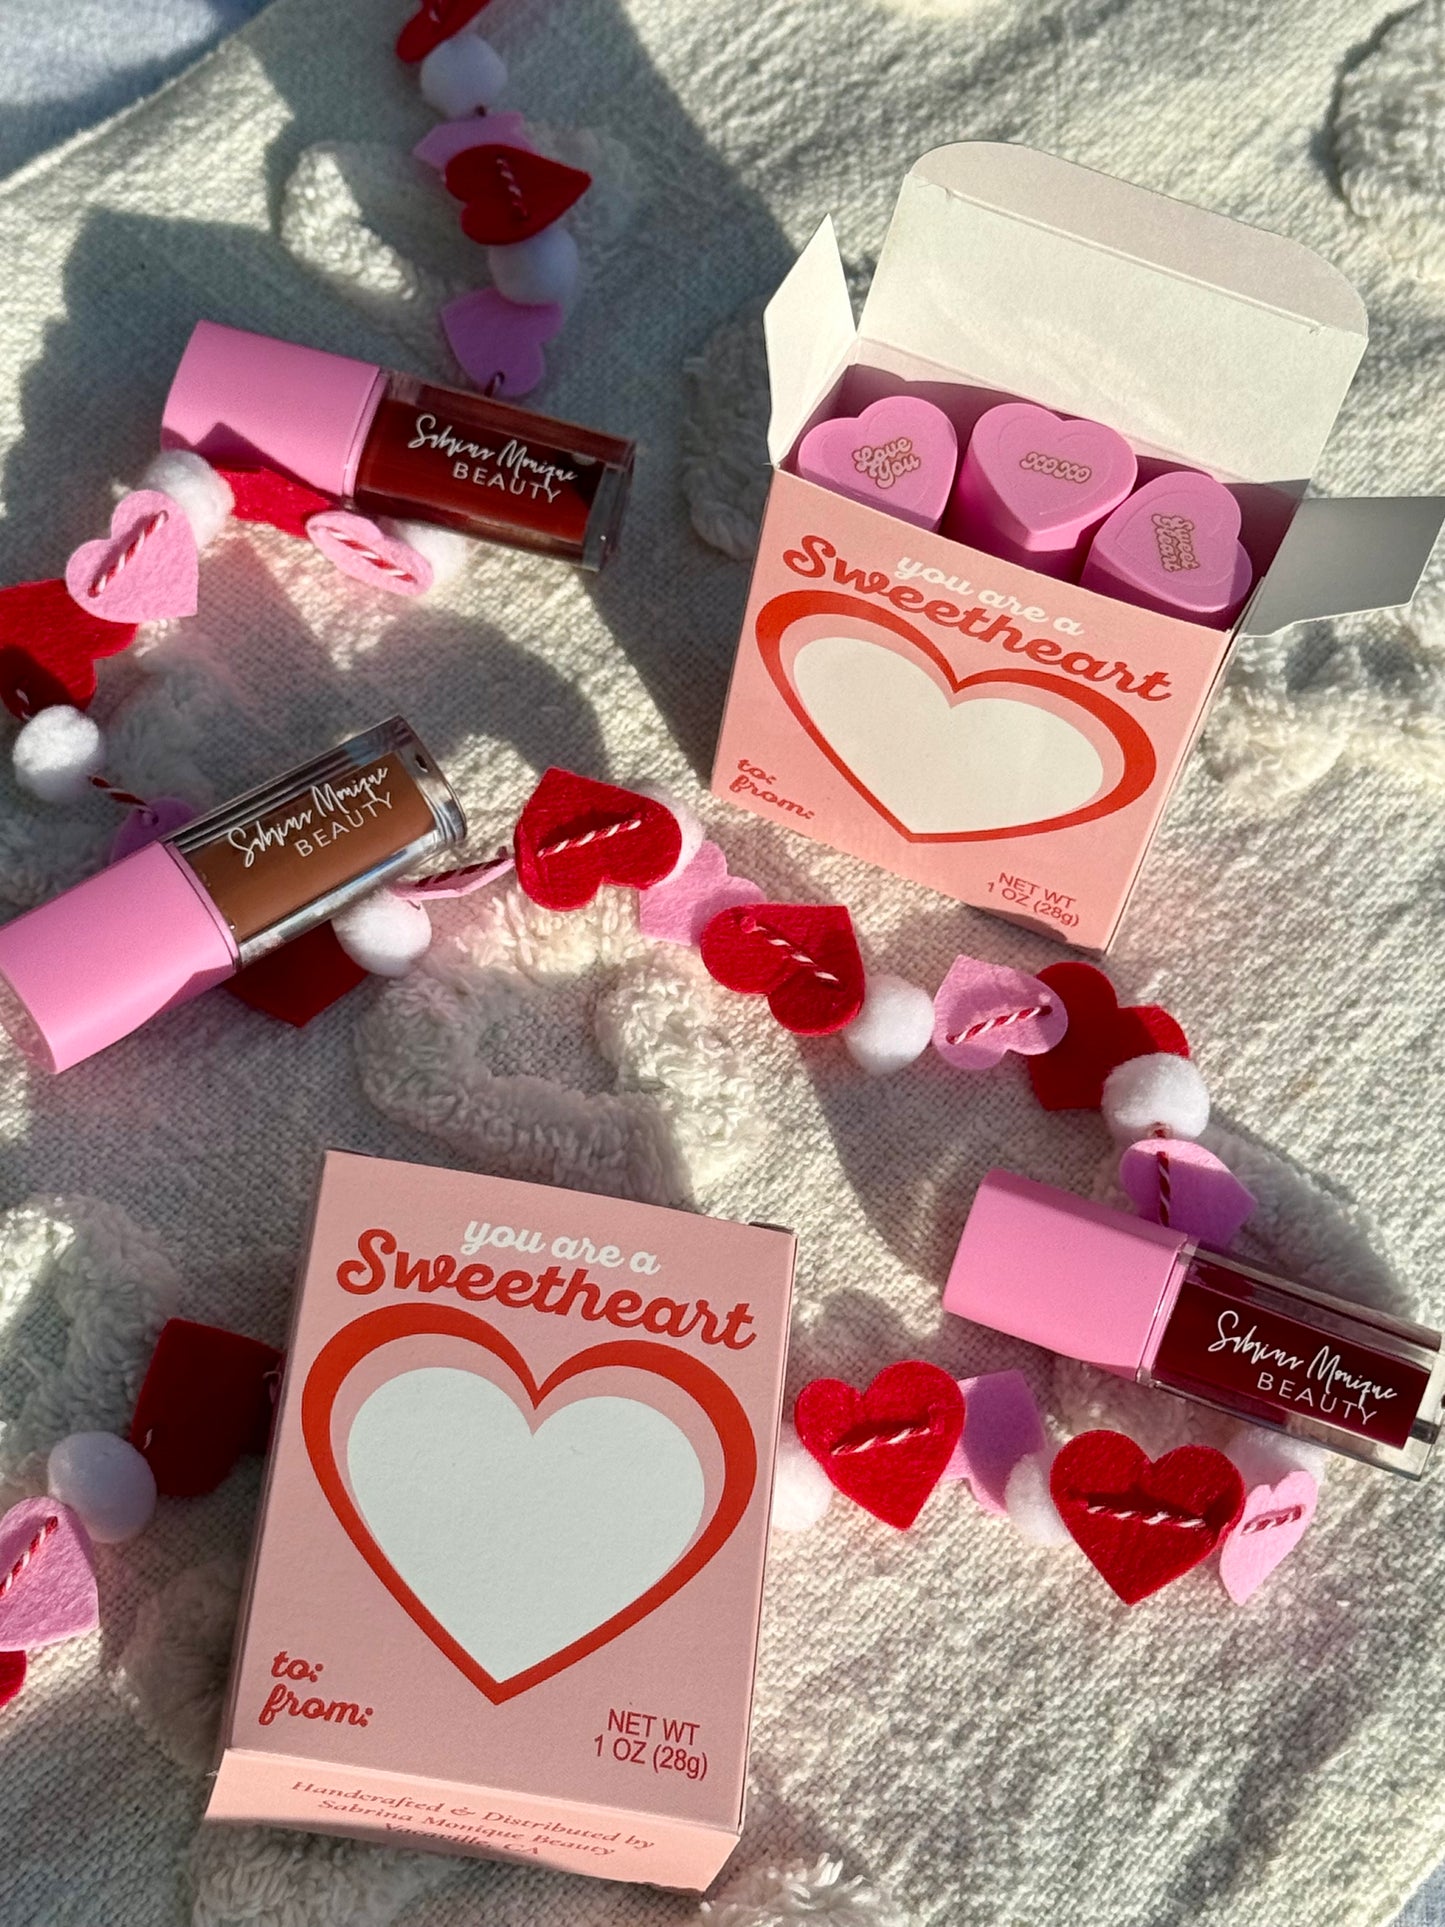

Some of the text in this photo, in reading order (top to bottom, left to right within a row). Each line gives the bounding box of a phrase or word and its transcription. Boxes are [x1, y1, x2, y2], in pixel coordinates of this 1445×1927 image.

[497, 439, 578, 490] Monique
[852, 437, 913, 473] Love
[868, 453, 921, 489] You
[452, 461, 562, 504] BEAUTY
[1172, 515, 1200, 570] Sweet
[782, 534, 1172, 702] Sweetheart
[896, 556, 1085, 637] you are a
[311, 767, 389, 817] Monique
[729, 774, 815, 819] from:
[737, 759, 777, 785] to:
[294, 791, 394, 857] BEAUTY
[987, 881, 1079, 928] 1 OZ (28g)
[999, 872, 1077, 908] NET WT
[460, 1219, 661, 1276] you are a
[336, 1228, 758, 1351] Sweetheart
[1256, 1371, 1378, 1426] BEAUTY
[1306, 1345, 1398, 1409] Monique
[271, 1650, 325, 1683] to:
[258, 1683, 374, 1728] from:
[608, 1707, 701, 1746] NET WT
[594, 1733, 708, 1781] 1 OZ (28g)
[291, 1781, 655, 1850] Handcrafted & Distributed by
[318, 1800, 615, 1856] Sabrina Monique Beauty
[503, 1843, 539, 1855] CA
